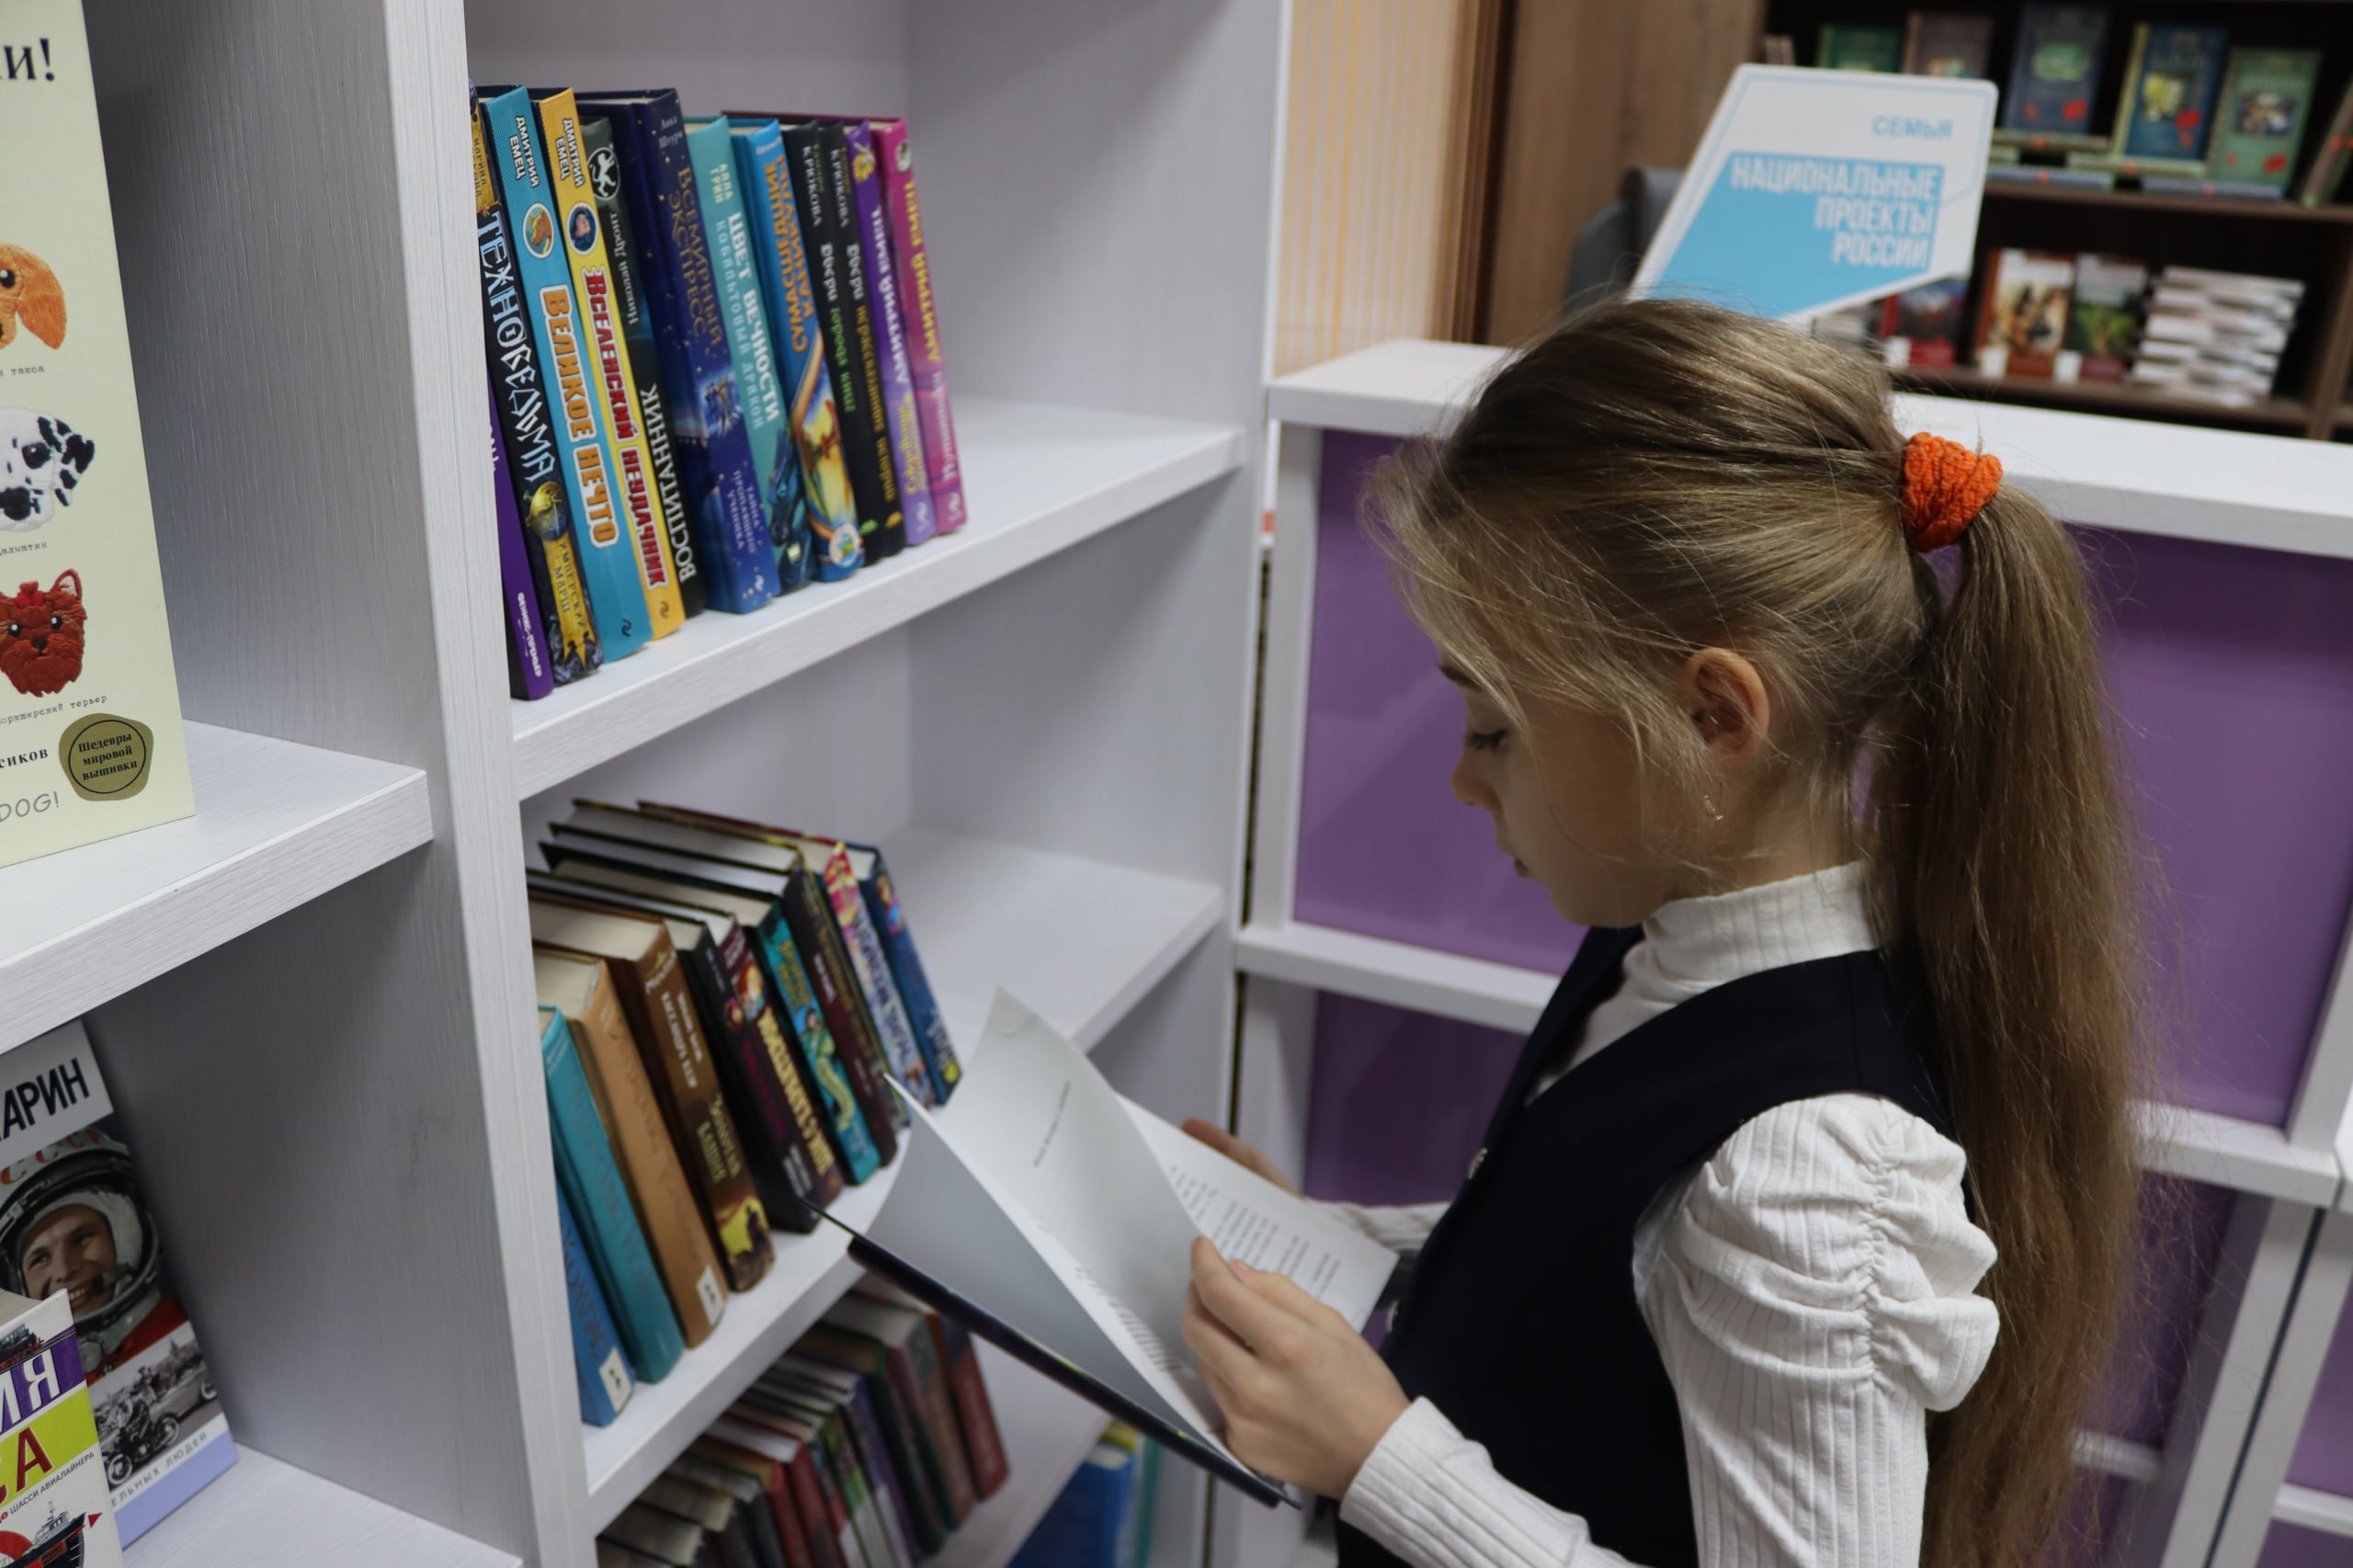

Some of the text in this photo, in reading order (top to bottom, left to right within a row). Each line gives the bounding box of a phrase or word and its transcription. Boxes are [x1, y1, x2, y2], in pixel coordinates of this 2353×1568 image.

[0, 38, 54, 82] и!
[509, 135, 526, 180] ЕМЕЦ
[516, 116, 540, 187] ДМИТРИЙ
[556, 138, 571, 181] ЕМЕЦ
[563, 118, 586, 187] ДМИТРИЙ
[1871, 116, 1953, 140] СЕМЬЯ
[802, 145, 823, 227] КРЮКОВА
[831, 149, 849, 228] КРЮКОВА
[1731, 155, 1936, 200] НАЦИОНАЛЬНЫЕ
[778, 153, 814, 319] КАНИКУЛЫ
[1813, 196, 1932, 234] ПРОЕКТЫ
[764, 163, 808, 352] СУМАСШЕДШИЕ
[1832, 232, 1928, 268] РОССИИ
[715, 220, 765, 429] КОБАЛЬТОВЫЙ ДРАКОН
[728, 211, 780, 422] ЦВЕТ ВЕЧНОСТИ
[878, 275, 908, 384] ДМИТРИЙ
[911, 252, 941, 361] ДМИТРИЙ
[11, 365, 44, 376] такса
[477, 210, 555, 482] ТЕХНОВЕДЬМА
[541, 287, 619, 546] ВЕЛИКОЕ НЕЧТО
[583, 267, 667, 589] ВСЕЛЕНСКИЙ НЕУДАЧНИК
[639, 382, 697, 583] ВОСПИТАННИК
[0, 541, 47, 556] алматин
[0, 695, 108, 724] оркширский терьер
[78, 733, 132, 753] Шедевры
[83, 745, 132, 766] мировой
[83, 761, 137, 780] вышивки
[0, 1058, 89, 1142] АРИН
[166, 1431, 207, 1468] ЛЮДЕЙ
[10, 1490, 39, 1514] ШАССИ
[40, 1452, 94, 1493] АВИАЛАЙНЕРА
